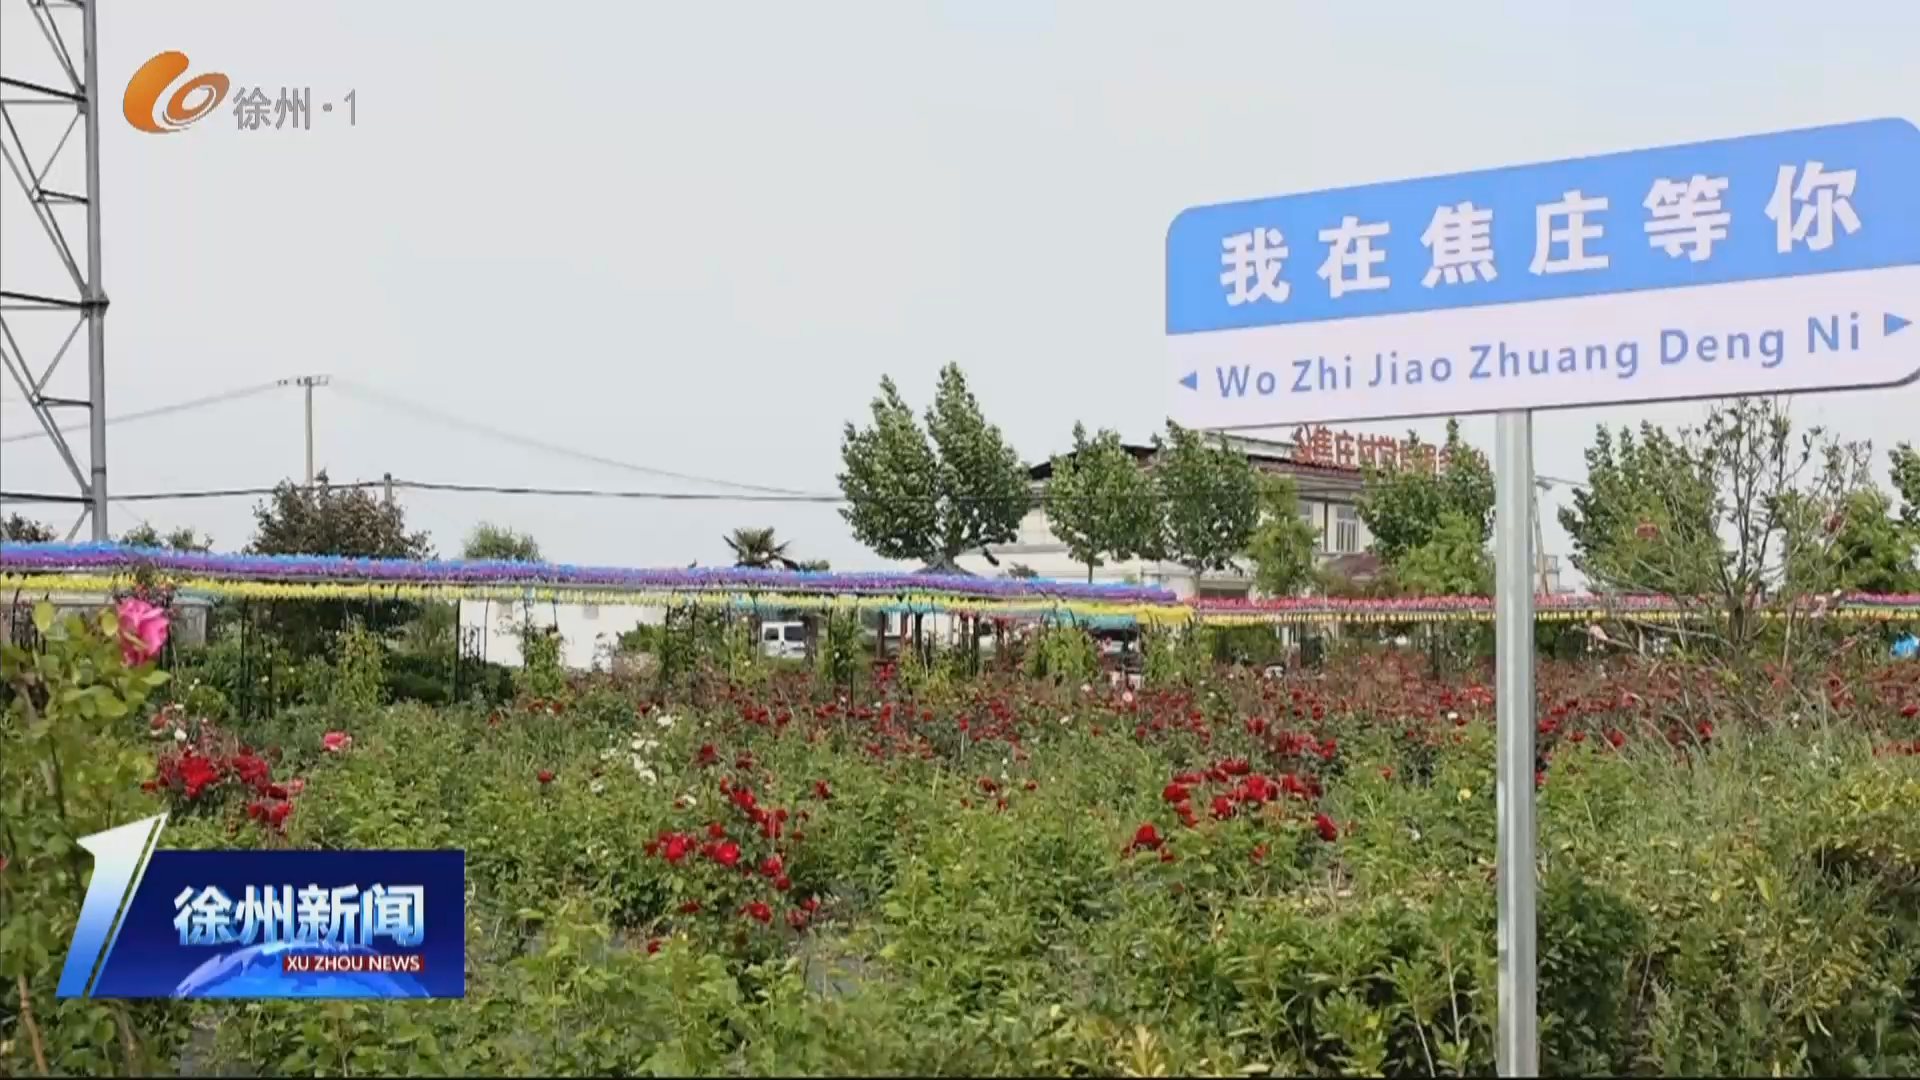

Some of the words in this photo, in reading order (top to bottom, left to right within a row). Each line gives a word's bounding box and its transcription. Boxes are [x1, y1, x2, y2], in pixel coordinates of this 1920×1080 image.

[1219, 160, 1862, 307] 我在焦庄等你
[1215, 364, 1277, 398] Wo
[1290, 355, 1353, 395] Zhi
[1367, 350, 1452, 388] Jiao
[1469, 340, 1639, 378] Zhuang
[1660, 328, 1785, 367] Deng
[1806, 310, 1861, 354] Ni
